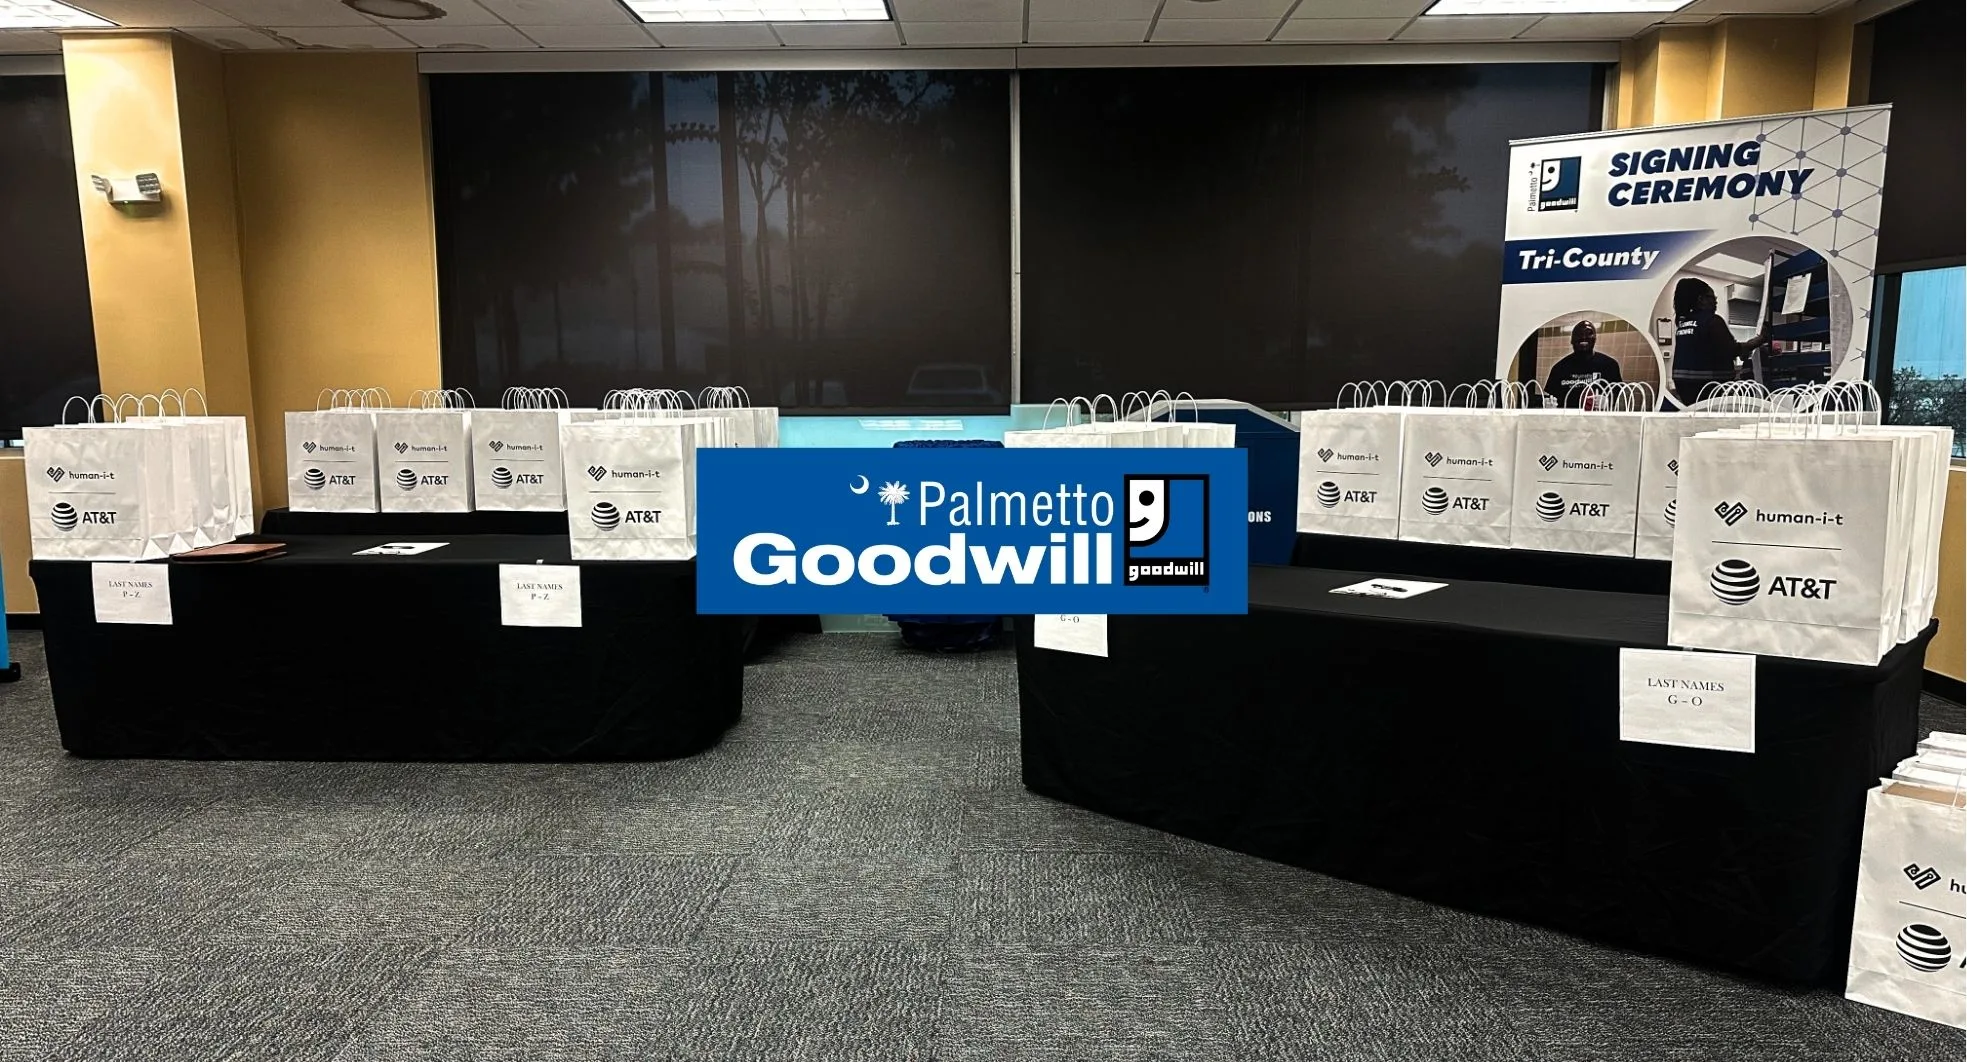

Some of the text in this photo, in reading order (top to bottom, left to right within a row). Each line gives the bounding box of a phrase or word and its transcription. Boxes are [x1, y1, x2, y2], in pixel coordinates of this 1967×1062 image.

[1607, 140, 1762, 177] SIGNING
[1527, 177, 1538, 211] Palmetto
[1607, 168, 1815, 207] CEREMONY
[1540, 197, 1577, 210] goodwill
[1518, 246, 1660, 271] Tri-County
[319, 444, 356, 453] human-i-t
[411, 444, 448, 452] human-i-t
[506, 443, 544, 451] human-i-t
[1337, 452, 1379, 462] human-i-t
[1446, 457, 1494, 467] human-i-t
[1562, 459, 1614, 471] human-i-t
[68, 470, 115, 481] human-i-t
[328, 474, 357, 486] AT&T
[420, 475, 449, 486] AT&T
[515, 474, 545, 485] AT&T
[611, 469, 660, 479] human-i-t
[1344, 490, 1378, 504] AT&T
[1452, 496, 1490, 511] AT&T
[1247, 510, 1272, 523] ONS
[1569, 502, 1610, 518] AT&T
[82, 511, 117, 525] AT&T
[624, 510, 662, 524] AT&T
[1756, 508, 1844, 526] human-i-t
[108, 580, 126, 588] LAST
[516, 582, 535, 590] LAST
[1767, 575, 1838, 600] AT&T
[1648, 677, 1725, 692] LAST NAMES
[1668, 694, 1678, 705] G
[1691, 696, 1703, 707] O
